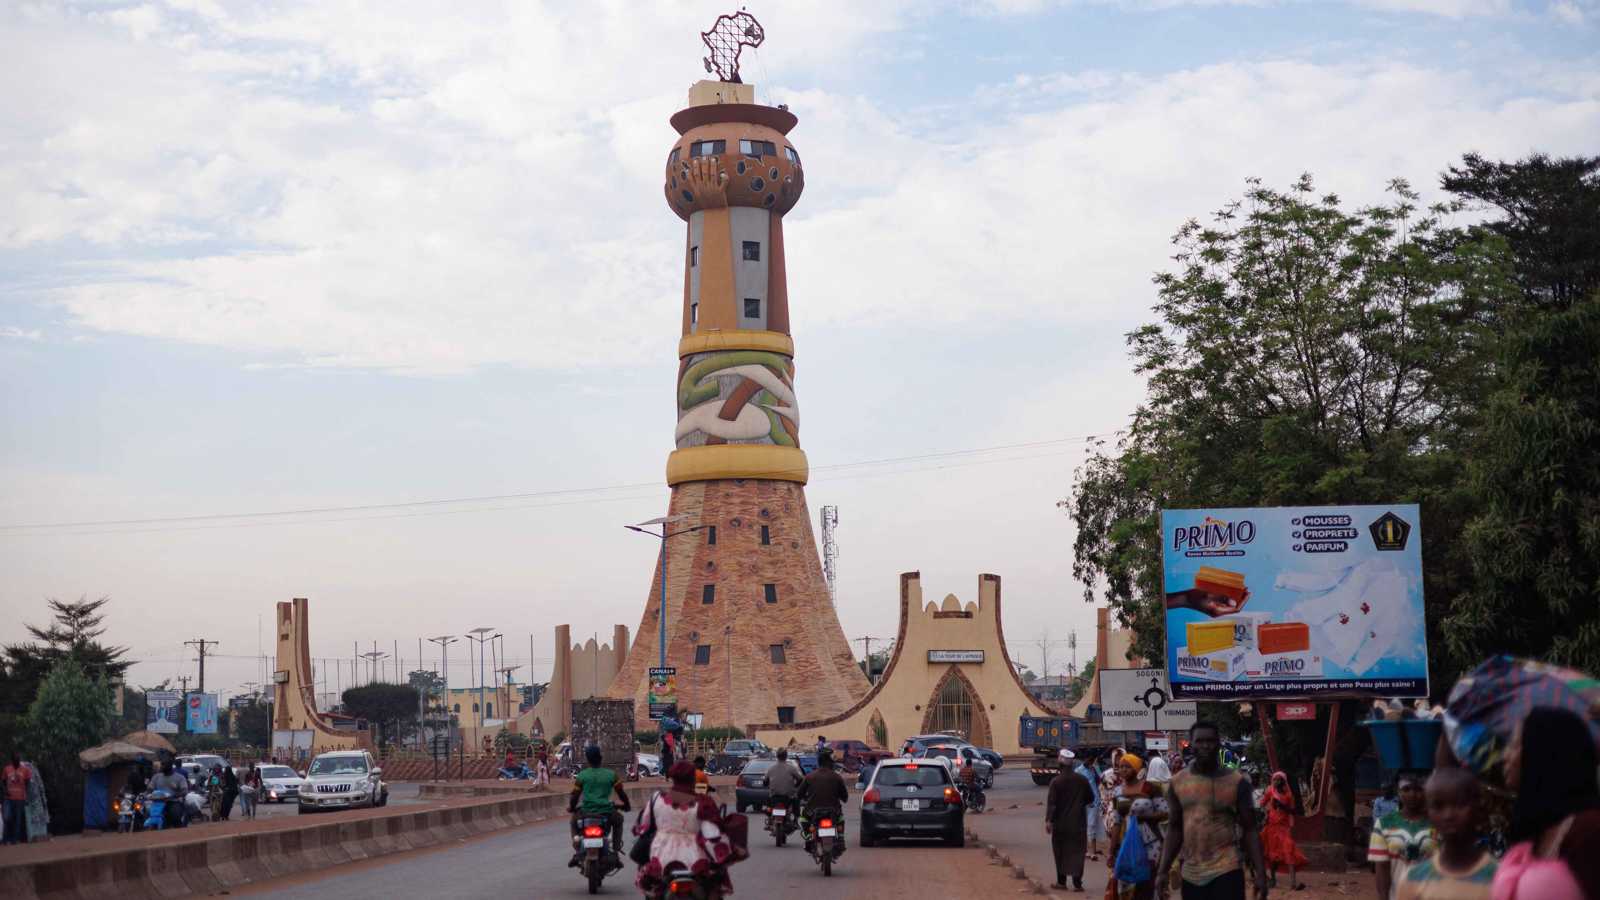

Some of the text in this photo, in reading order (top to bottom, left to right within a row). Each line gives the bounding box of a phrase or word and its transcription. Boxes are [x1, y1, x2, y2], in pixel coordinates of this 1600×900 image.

[1305, 516, 1349, 525] MOUSSES
[1174, 519, 1256, 552] PRIMO
[1306, 543, 1345, 551] PARFUM
[1177, 656, 1209, 669] PRIMO
[1264, 658, 1305, 673] PRIMO
[1206, 683, 1233, 691] PRIMO,
[1265, 682, 1285, 691] Linge
[1286, 682, 1302, 691] plus
[1304, 682, 1328, 690] propre
[1355, 681, 1373, 689] Peau
[1374, 680, 1390, 689] plus
